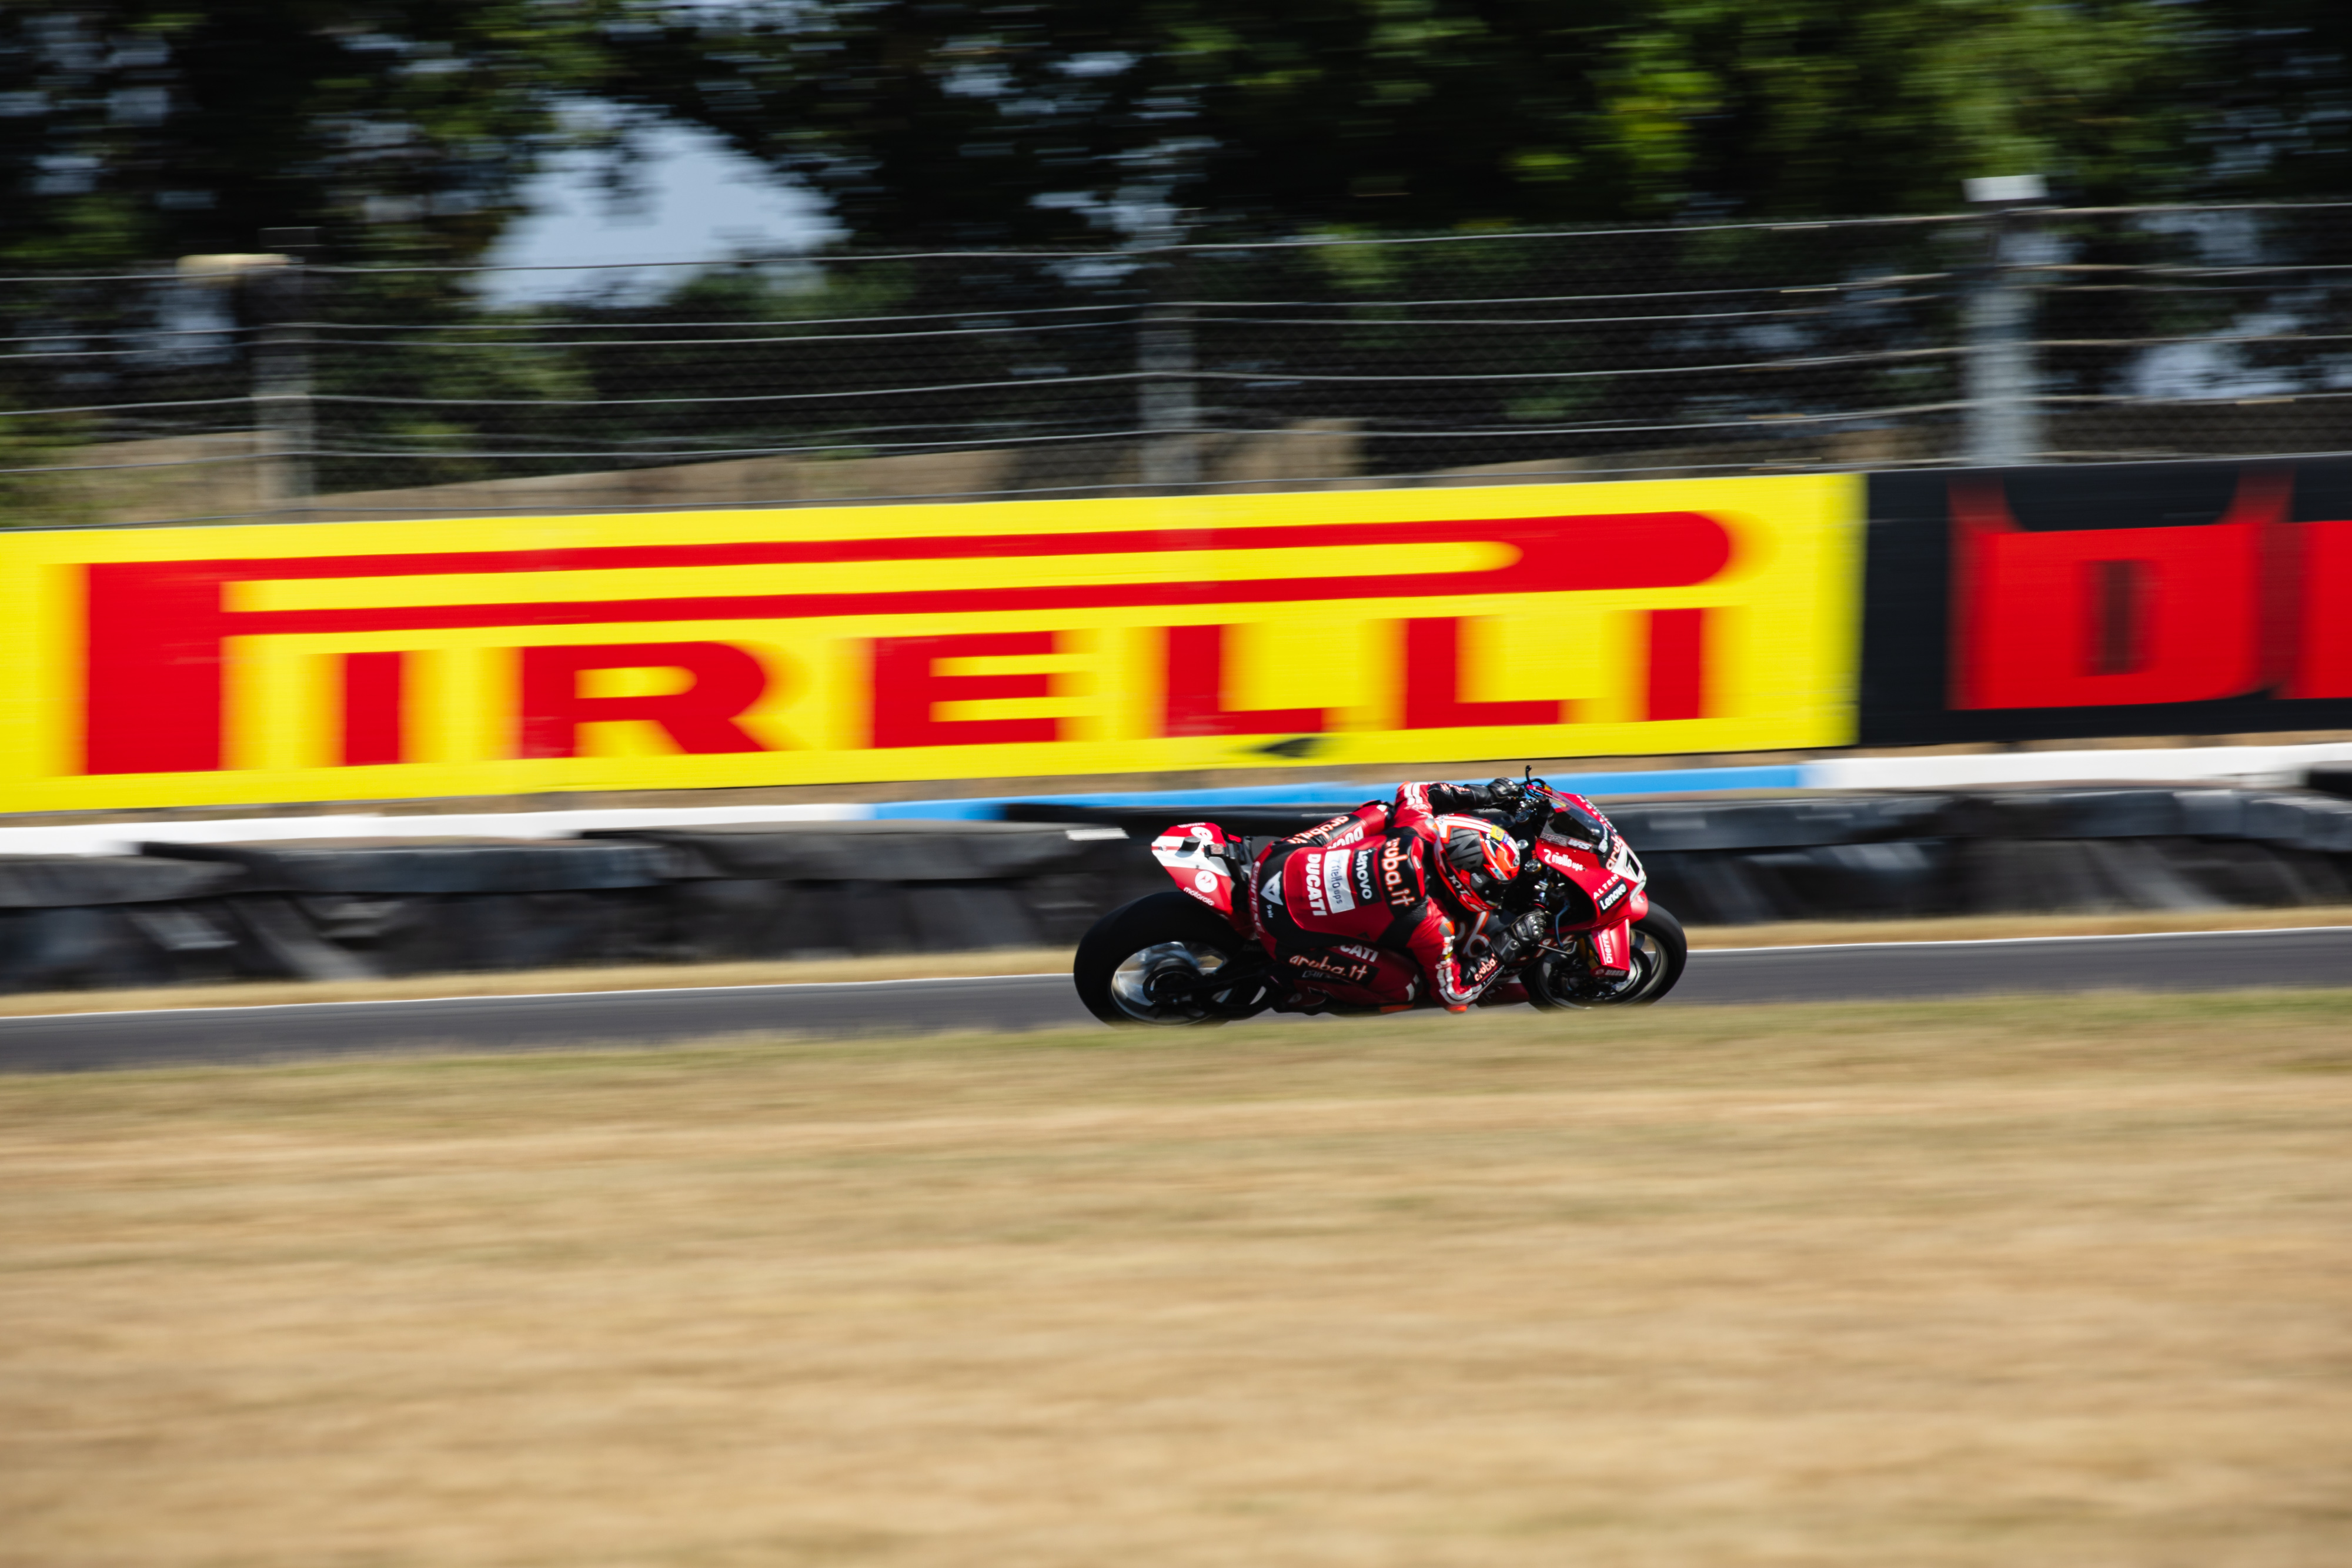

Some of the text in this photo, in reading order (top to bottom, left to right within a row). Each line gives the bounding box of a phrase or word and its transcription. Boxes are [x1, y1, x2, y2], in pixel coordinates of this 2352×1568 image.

[1952, 506, 2352, 710] D
[59, 510, 1749, 776] PIRELLI
[1183, 887, 1215, 906] motorola
[1305, 854, 1328, 916] DUCATI
[1593, 874, 1619, 900] ALTEN
[1599, 883, 1626, 910] Lenovo
[1601, 933, 1613, 964] Dierre
[1289, 955, 1367, 981] aruba.it
